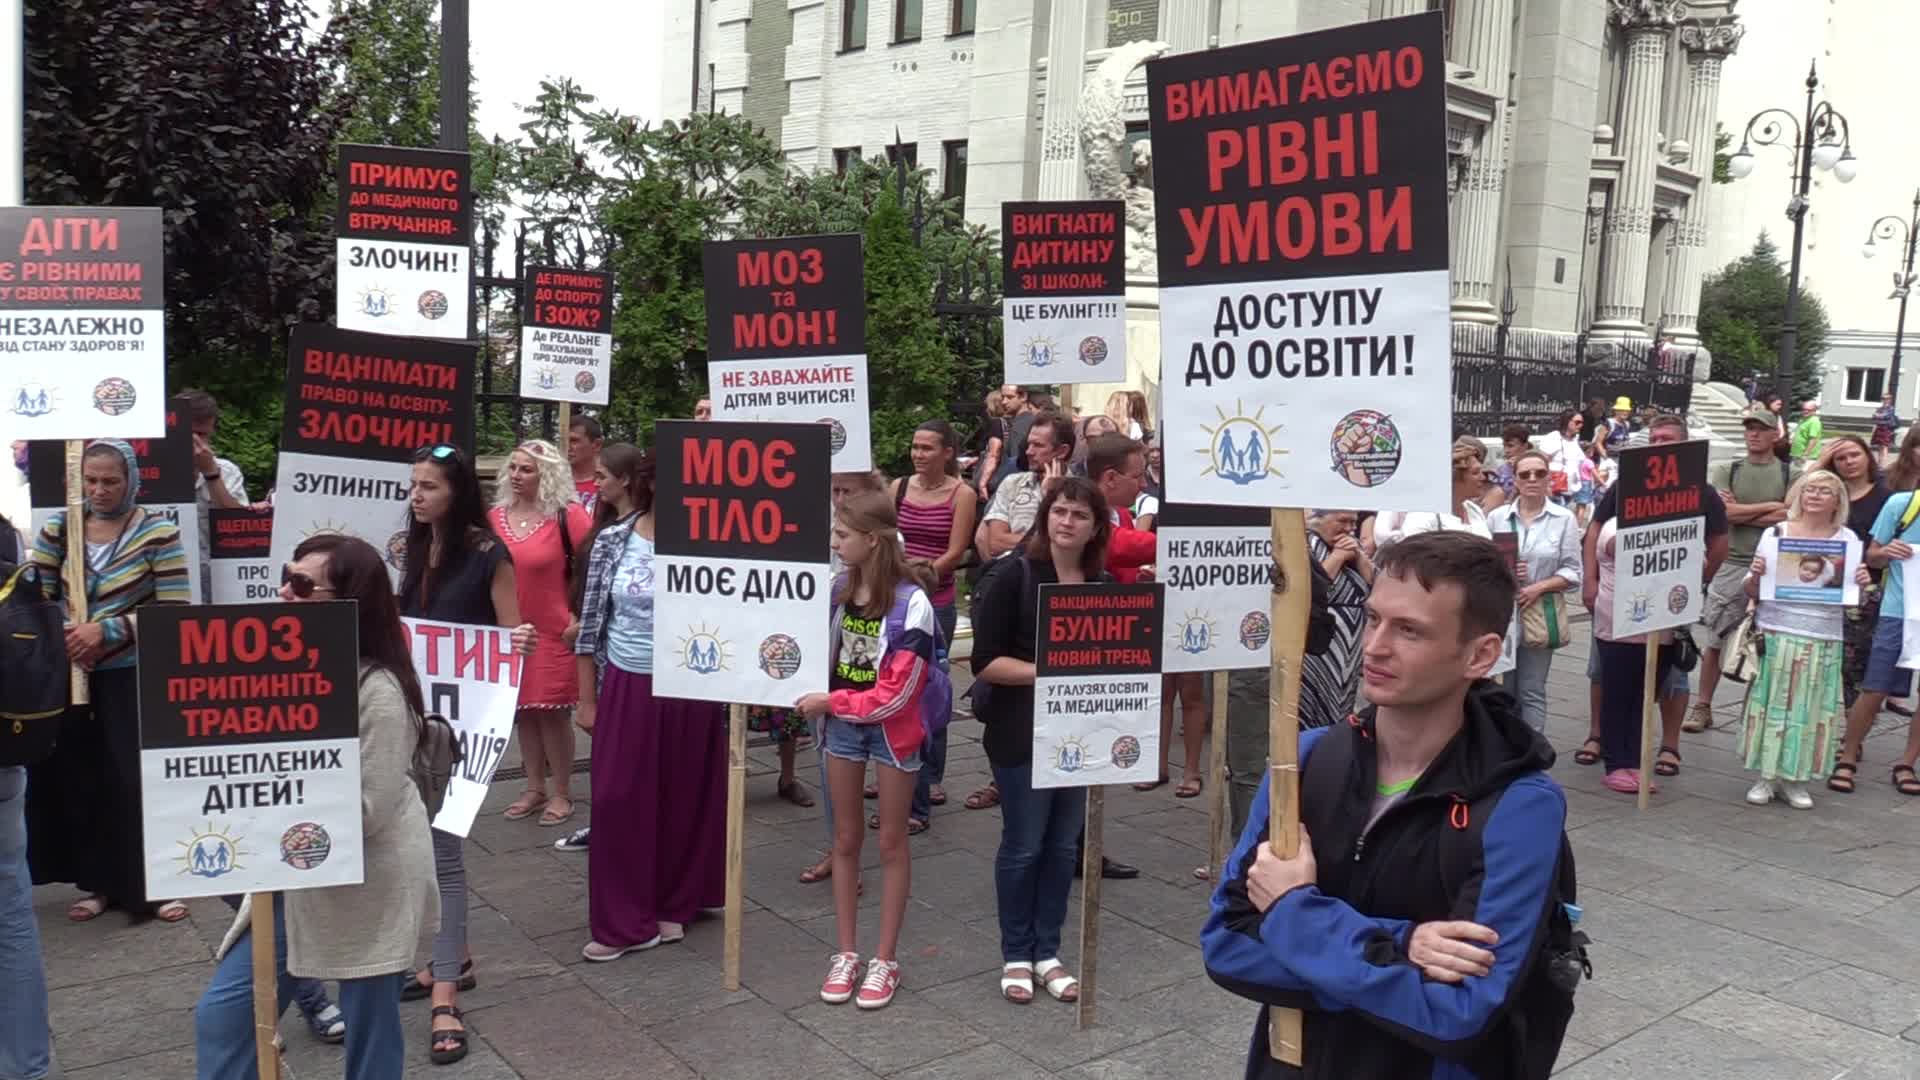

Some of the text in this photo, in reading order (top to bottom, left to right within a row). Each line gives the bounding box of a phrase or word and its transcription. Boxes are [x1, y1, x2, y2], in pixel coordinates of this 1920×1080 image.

[1166, 46, 1423, 122] ВИМАГАЄМО
[1207, 110, 1379, 192] РІВНІ
[350, 162, 458, 192] ПРИМУС
[350, 192, 458, 211] ДО МЕДИЧНОГО
[20, 217, 120, 256] ДІТИ
[349, 212, 458, 235] ВТРУЧАННЯ-
[1012, 213, 1115, 236] ВИГНАТИ
[1179, 185, 1412, 267] УМОВИ
[349, 246, 458, 272] ЗЛОЧИН!
[736, 248, 824, 288] МОЗ
[1012, 240, 1115, 269] ДИТИНУ
[0, 262, 142, 281] Є РІВНИМИ
[536, 272, 603, 288] ДЕ ПРИМУС
[1022, 273, 1107, 289] ЗІ ШКОЛИ-
[73, 286, 143, 301] ПРАВАХ
[535, 288, 603, 304] ДО СПОРТУ
[771, 289, 796, 307] та
[0, 317, 144, 336] НЕЗАЛЕЖНО
[545, 304, 600, 328] ЗОЖ?
[1012, 303, 1117, 322] ЦЕ БУЛІНГ!!!
[1214, 287, 1383, 338] ДОСТУПУ
[533, 330, 601, 347] Де РЕАЛЬНЕ
[733, 310, 838, 349] МОН!
[22, 340, 67, 352] СТАНУ
[533, 353, 550, 362] ПРО
[303, 348, 457, 390] ВІДНІМАТИ
[1185, 335, 1414, 387] ДО ОСВІТИ!
[722, 364, 855, 388] НЕ ЗАВАЖАЙТЕ
[300, 384, 453, 414] ПРАВО НА ОСВІТУ-
[724, 388, 856, 411] ДІТЯМ ВЧИТИСЯ!
[299, 409, 454, 448] ЗЛОЧИН!
[682, 437, 796, 489] МОЄ
[1646, 454, 1680, 490] ЗА
[293, 472, 409, 501] ЗУПИНІТЬ
[1625, 486, 1699, 518] ВІЛЬНИЙ
[683, 497, 799, 545] ТІЛО-
[1623, 520, 1698, 550] МЕДИЧНИЙ
[1168, 540, 1189, 558] НЕ
[1632, 547, 1688, 577] ВИБІР
[667, 564, 816, 604] МОЄ ДІЛО
[1168, 564, 1274, 591] ЗДОРОВИХ
[1050, 592, 1154, 610] ВАКЦИНАЛЬНИЙ
[179, 615, 319, 669] МОЗ,
[1050, 615, 1139, 642] БУЛІНГ
[1048, 647, 1152, 666] НОВИЙ ТРЕНД
[167, 672, 332, 702] ПРИПИНІТЬ
[1048, 682, 1149, 697] У ГАЛУЗЯХ ОСВІТИ
[182, 704, 319, 737] ТРАВЛЮ
[1046, 699, 1149, 715] ТА МЕДИЦИНИ!
[165, 748, 343, 780] НЕЩЕПЛЕНИХ
[202, 774, 304, 815] ДІТЕЙ!
